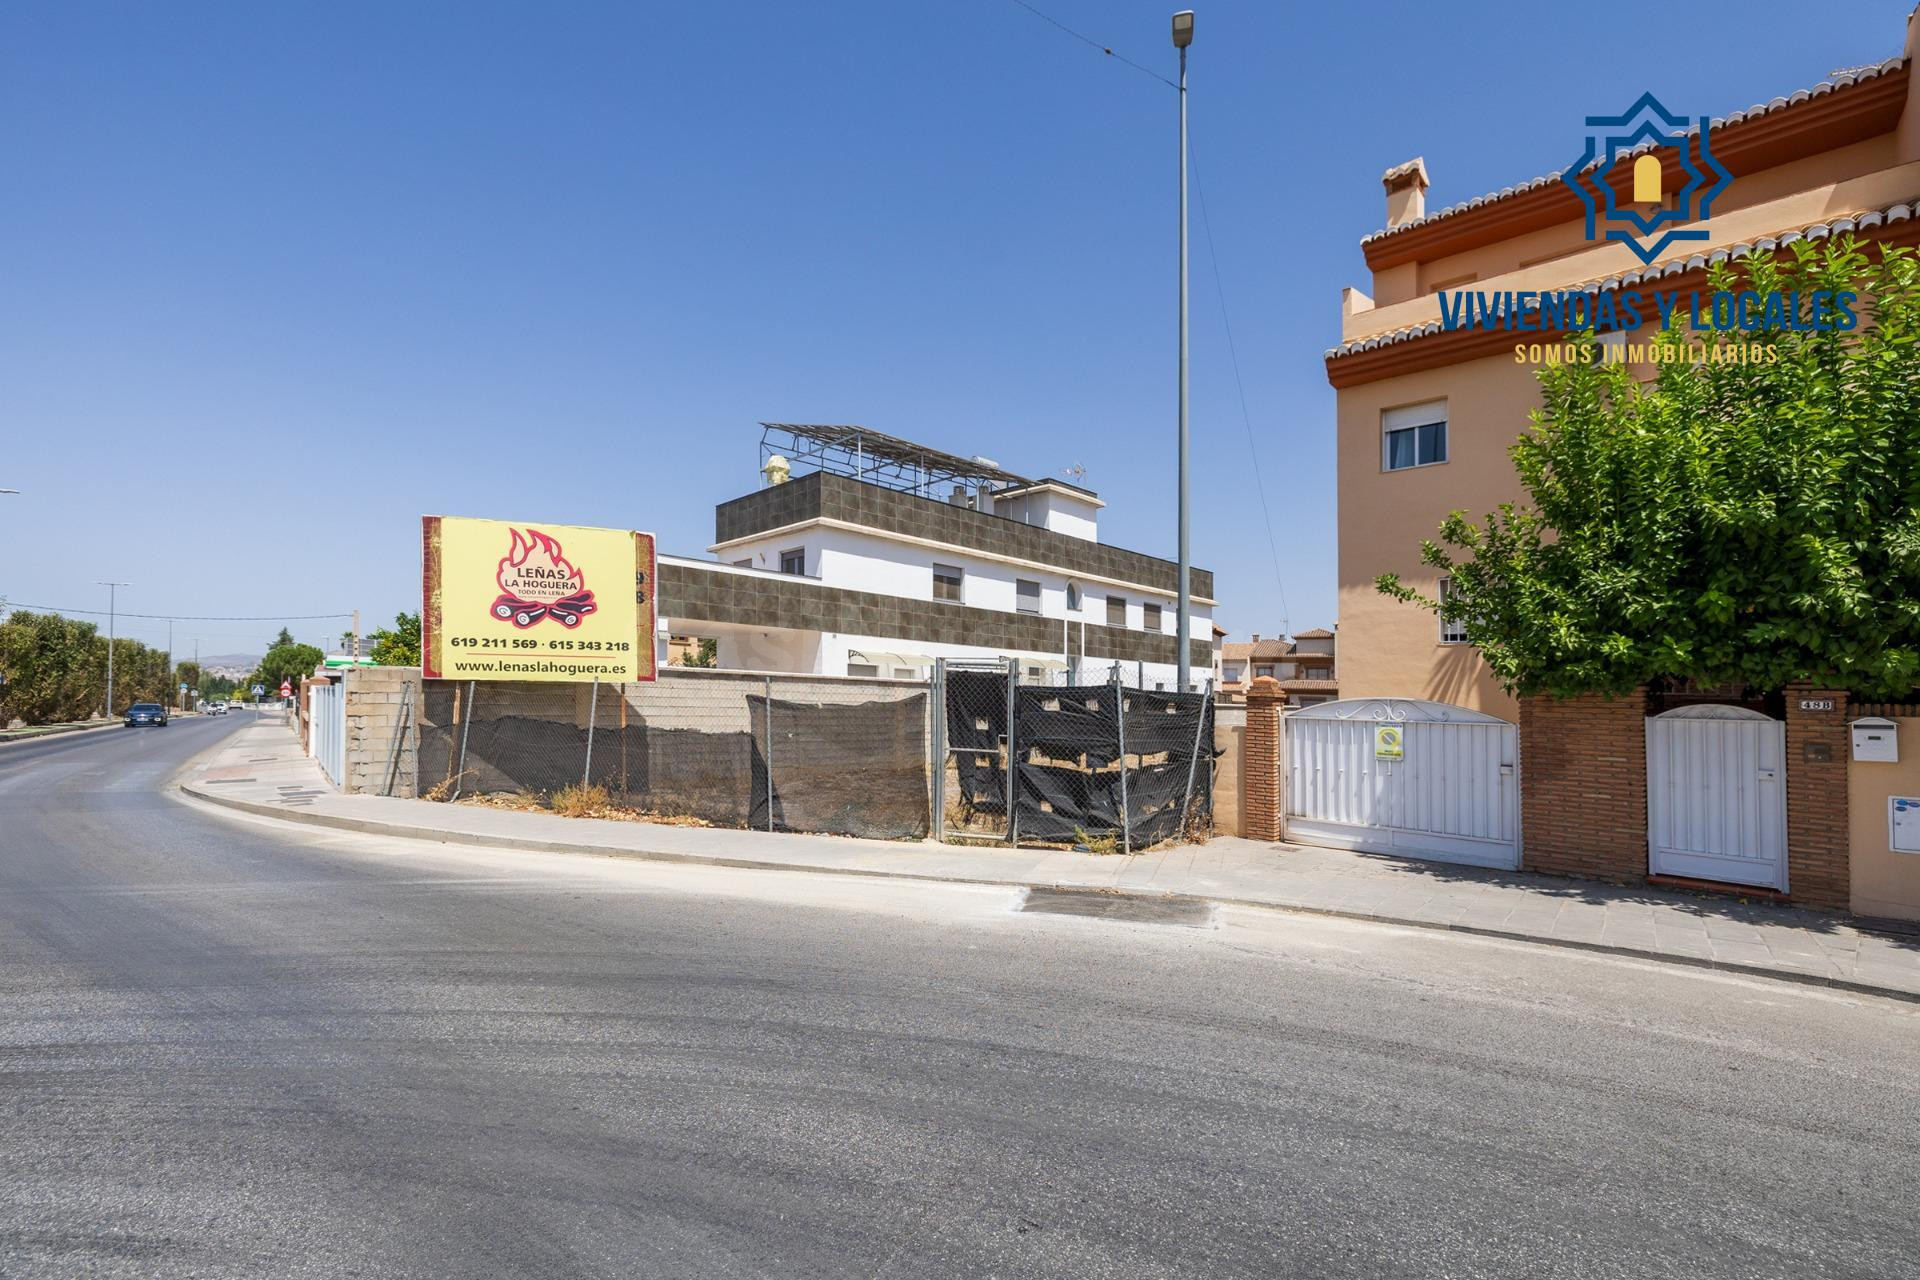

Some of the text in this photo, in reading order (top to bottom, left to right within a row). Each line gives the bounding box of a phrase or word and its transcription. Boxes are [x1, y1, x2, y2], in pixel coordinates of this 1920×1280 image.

[517, 566, 566, 580] LEÑAS
[505, 579, 578, 590] LA HOGUERA
[451, 637, 630, 651] 619 211 569 615 343 218
[455, 660, 627, 676] www.lenaslahoguera.es
